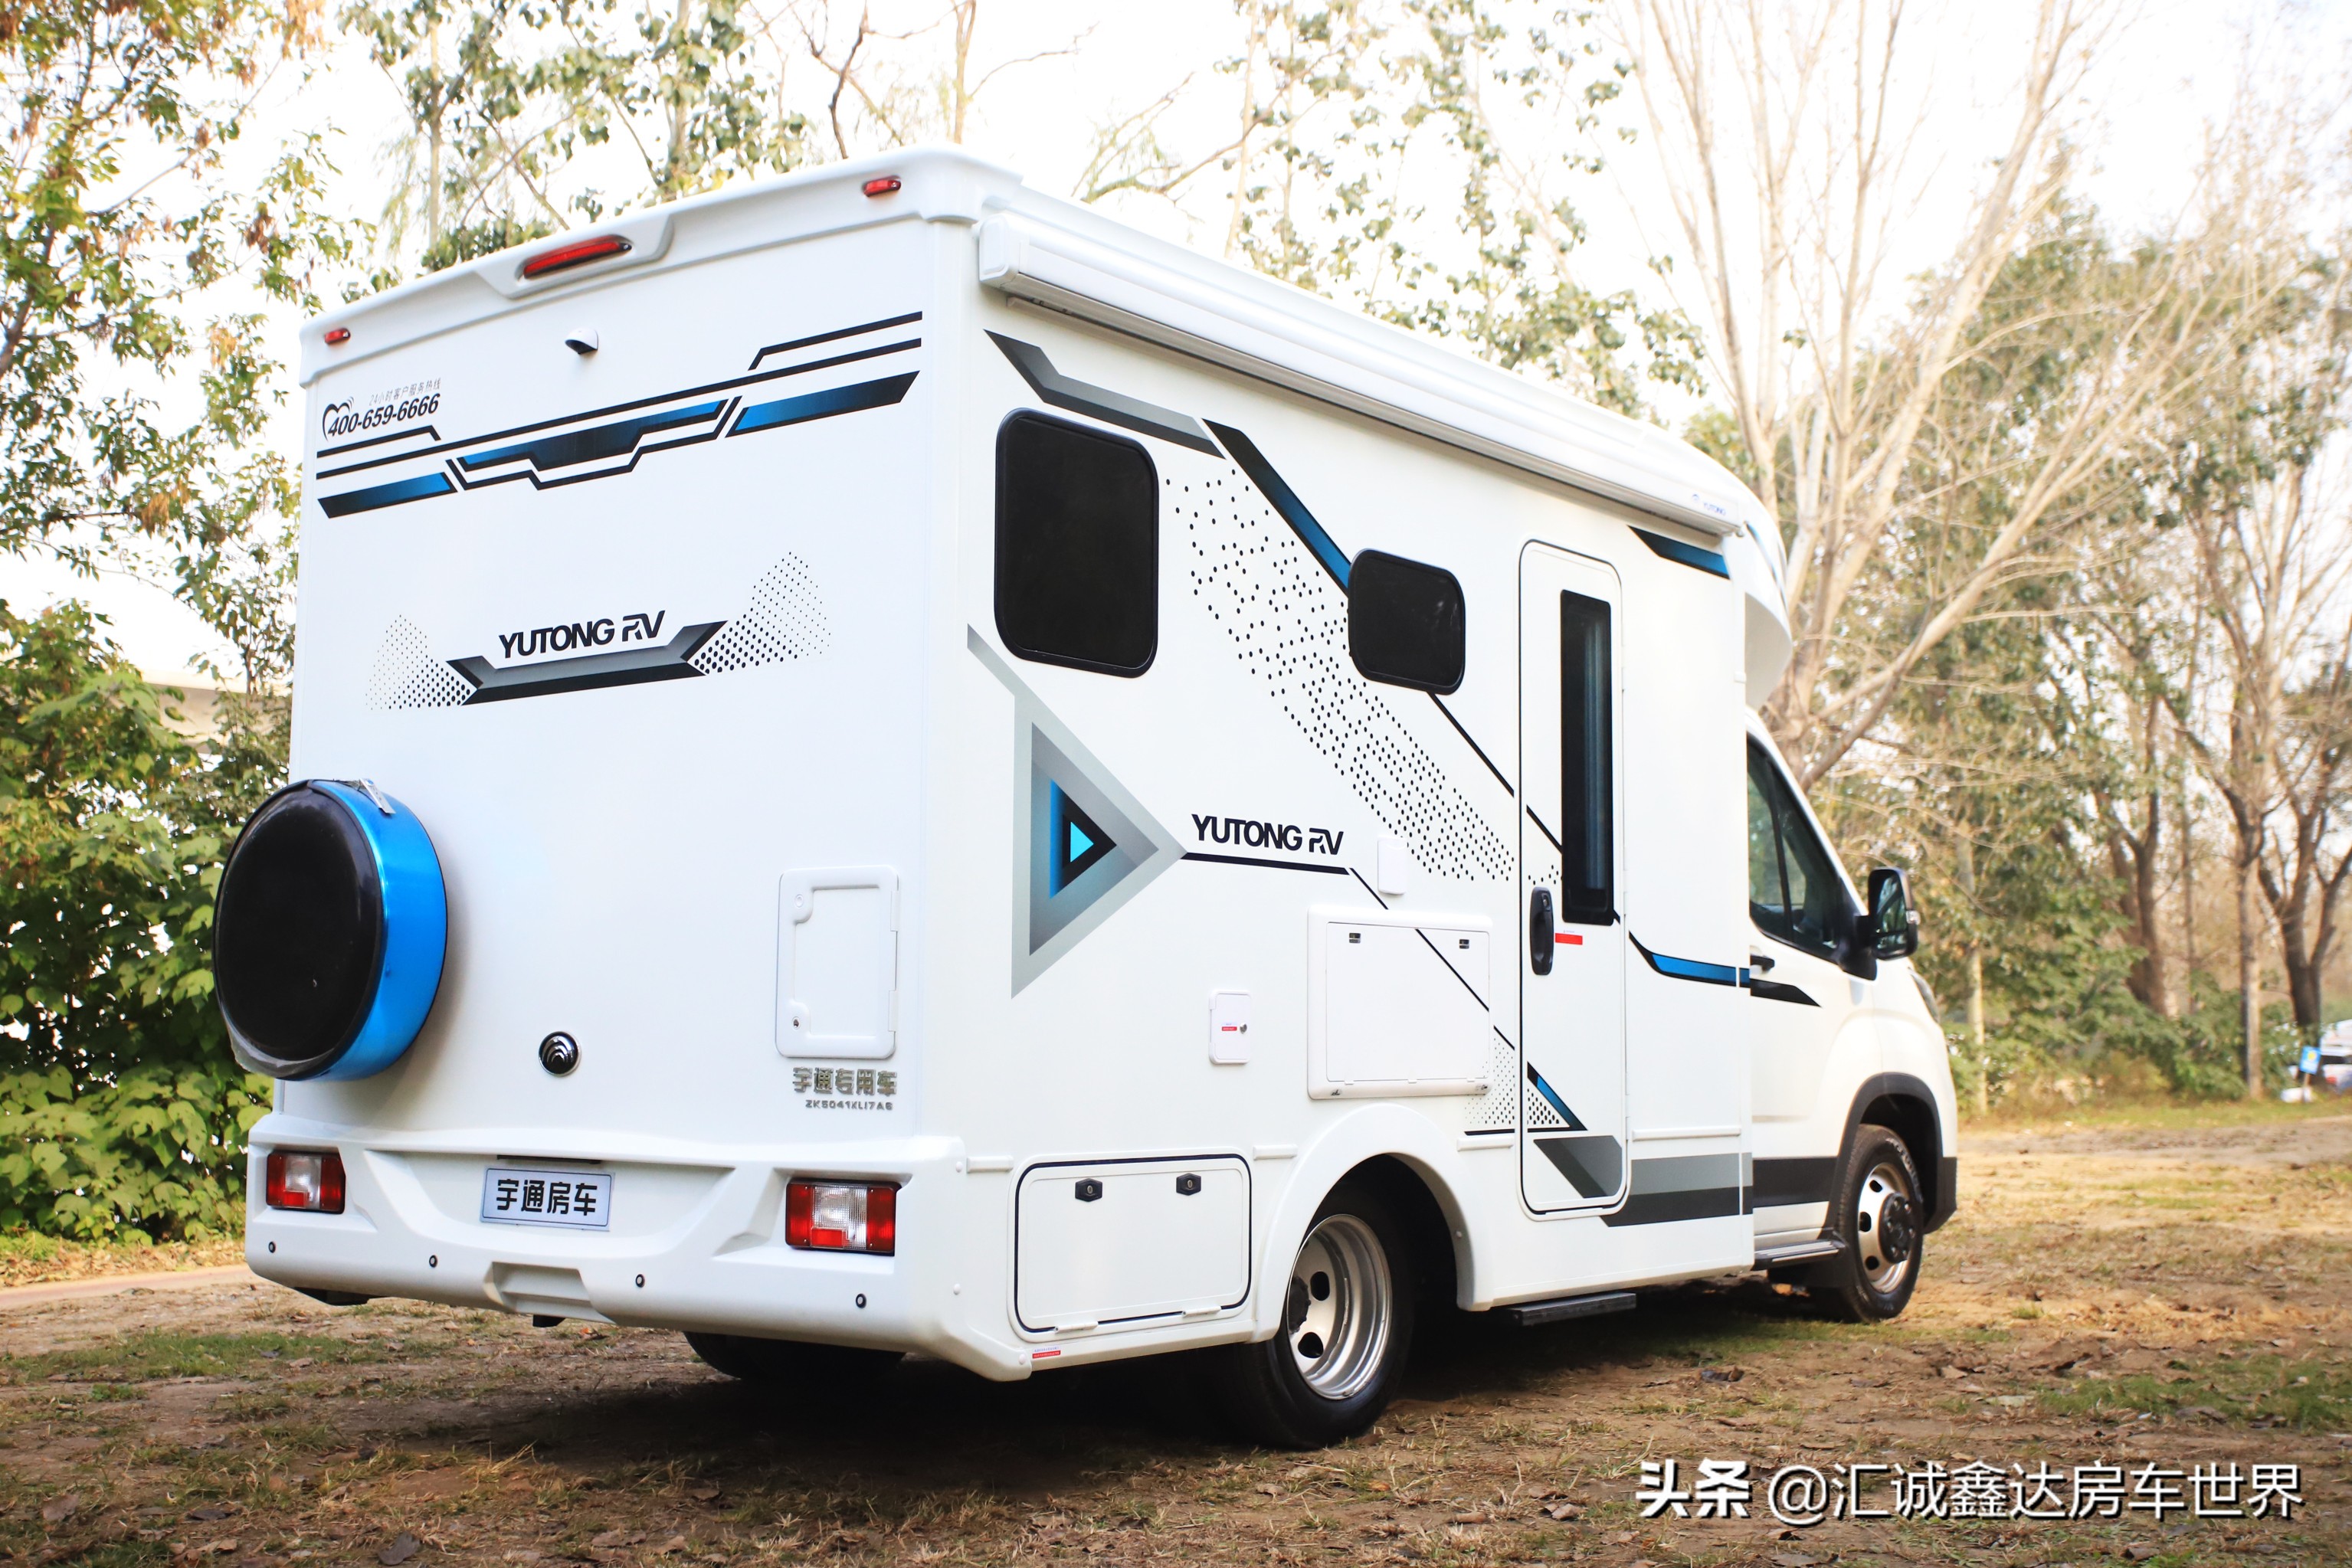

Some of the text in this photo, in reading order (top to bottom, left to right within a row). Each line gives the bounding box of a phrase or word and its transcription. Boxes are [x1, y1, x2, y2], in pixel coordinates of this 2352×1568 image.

[328, 393, 441, 437] 400-659-6666
[499, 610, 666, 659] YUTONG RV
[1191, 813, 1345, 855] YUTONG RV
[792, 1067, 897, 1096] 宇通专用车
[496, 1178, 598, 1216] 宇通房车
